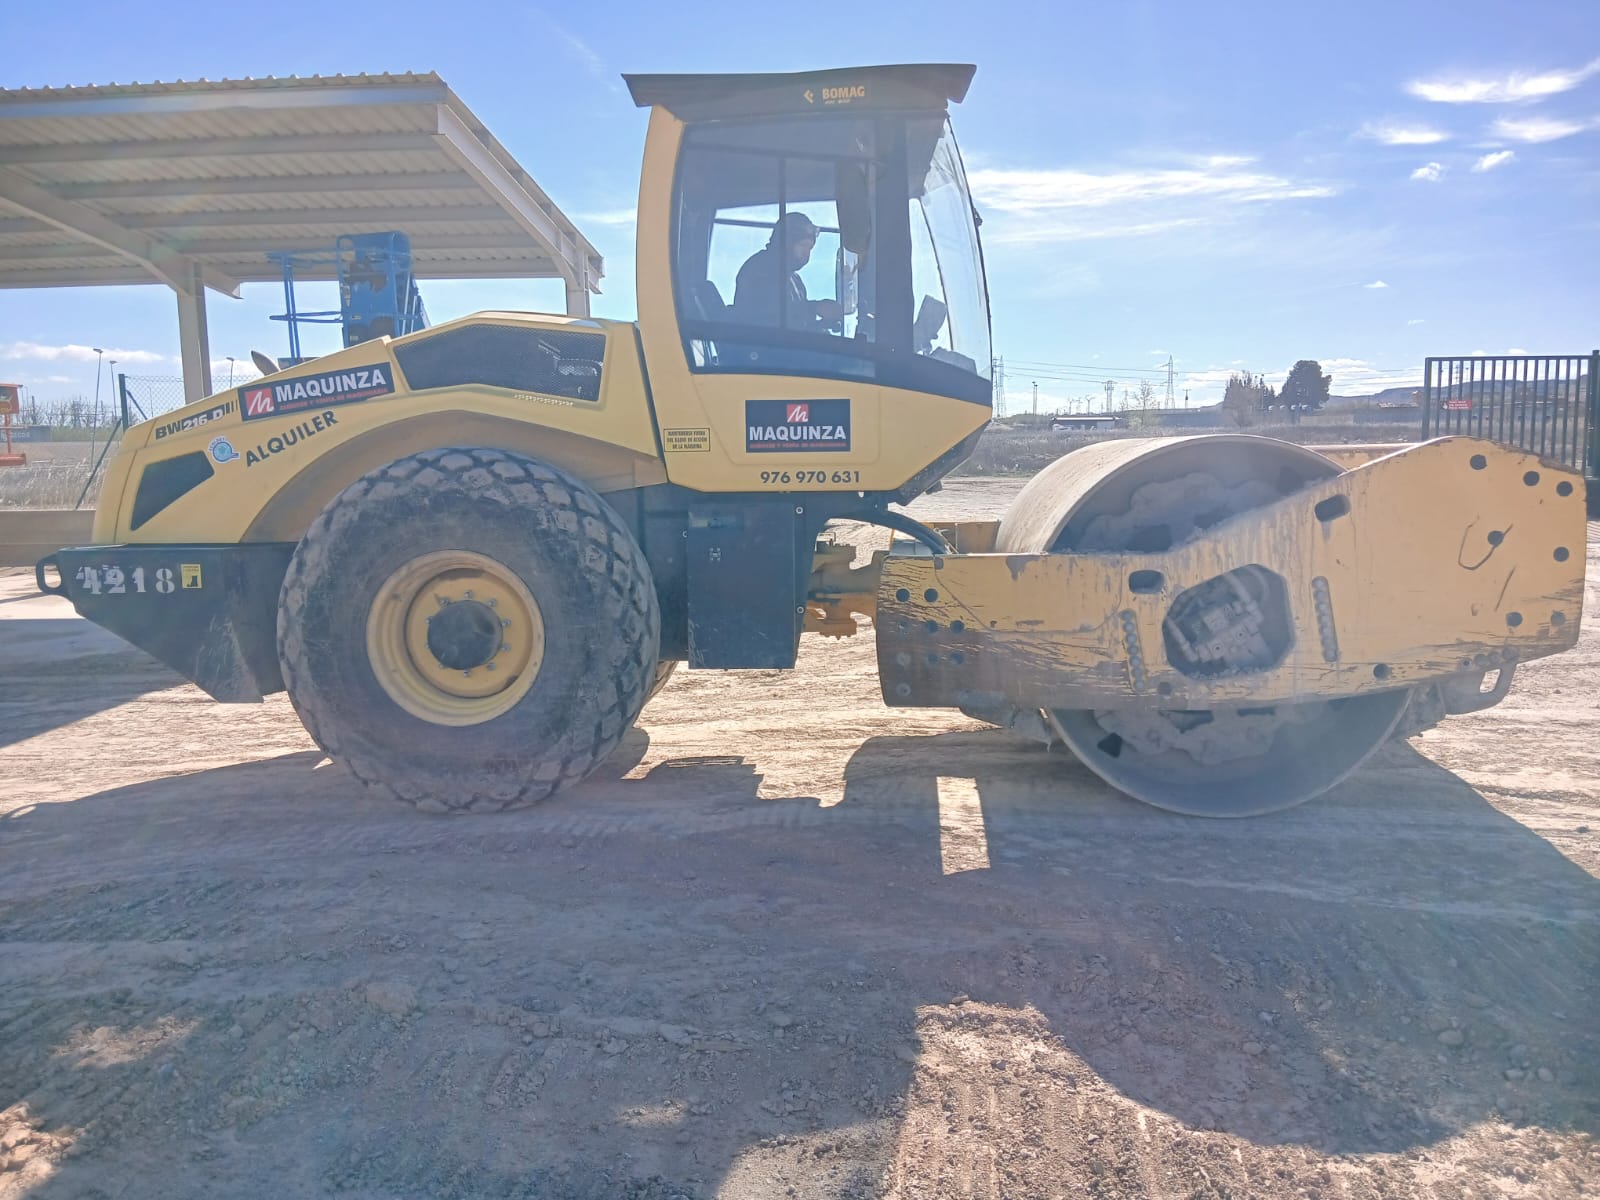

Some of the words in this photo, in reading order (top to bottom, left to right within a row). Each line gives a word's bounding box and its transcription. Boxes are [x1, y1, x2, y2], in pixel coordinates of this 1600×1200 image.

[822, 86, 865, 99] BOMAG
[275, 369, 386, 402] MAQUINZA
[246, 410, 339, 467] ALQUILER
[749, 425, 847, 441] MAQUINZA
[760, 471, 791, 484] 976
[796, 471, 826, 484] 970
[831, 471, 860, 483] 631
[76, 565, 175, 594] 4218
